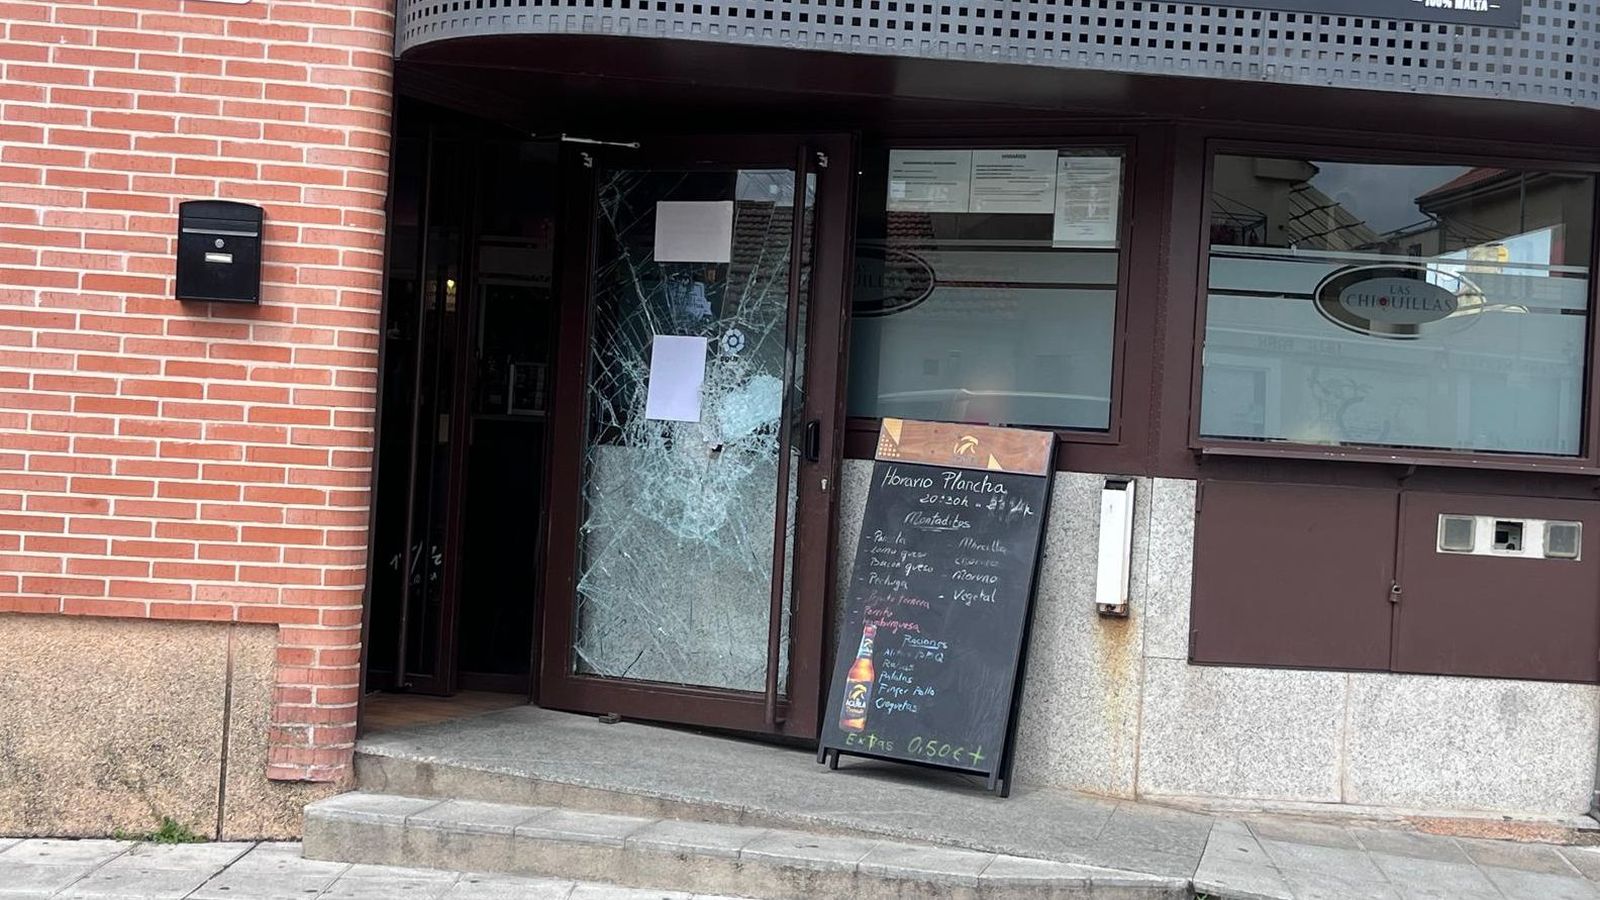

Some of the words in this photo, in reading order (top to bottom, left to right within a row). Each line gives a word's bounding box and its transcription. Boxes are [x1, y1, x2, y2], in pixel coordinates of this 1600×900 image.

[1454, 0, 1488, 11] MALTA
[1390, 285, 1411, 295] LAS
[1346, 294, 1451, 311] CHIQUILLAS
[881, 466, 933, 488] Horario
[942, 471, 1008, 494] Plancha
[904, 511, 972, 529] Montaditos
[953, 588, 997, 607] Vegetal
[907, 736, 964, 761] 0,50€
